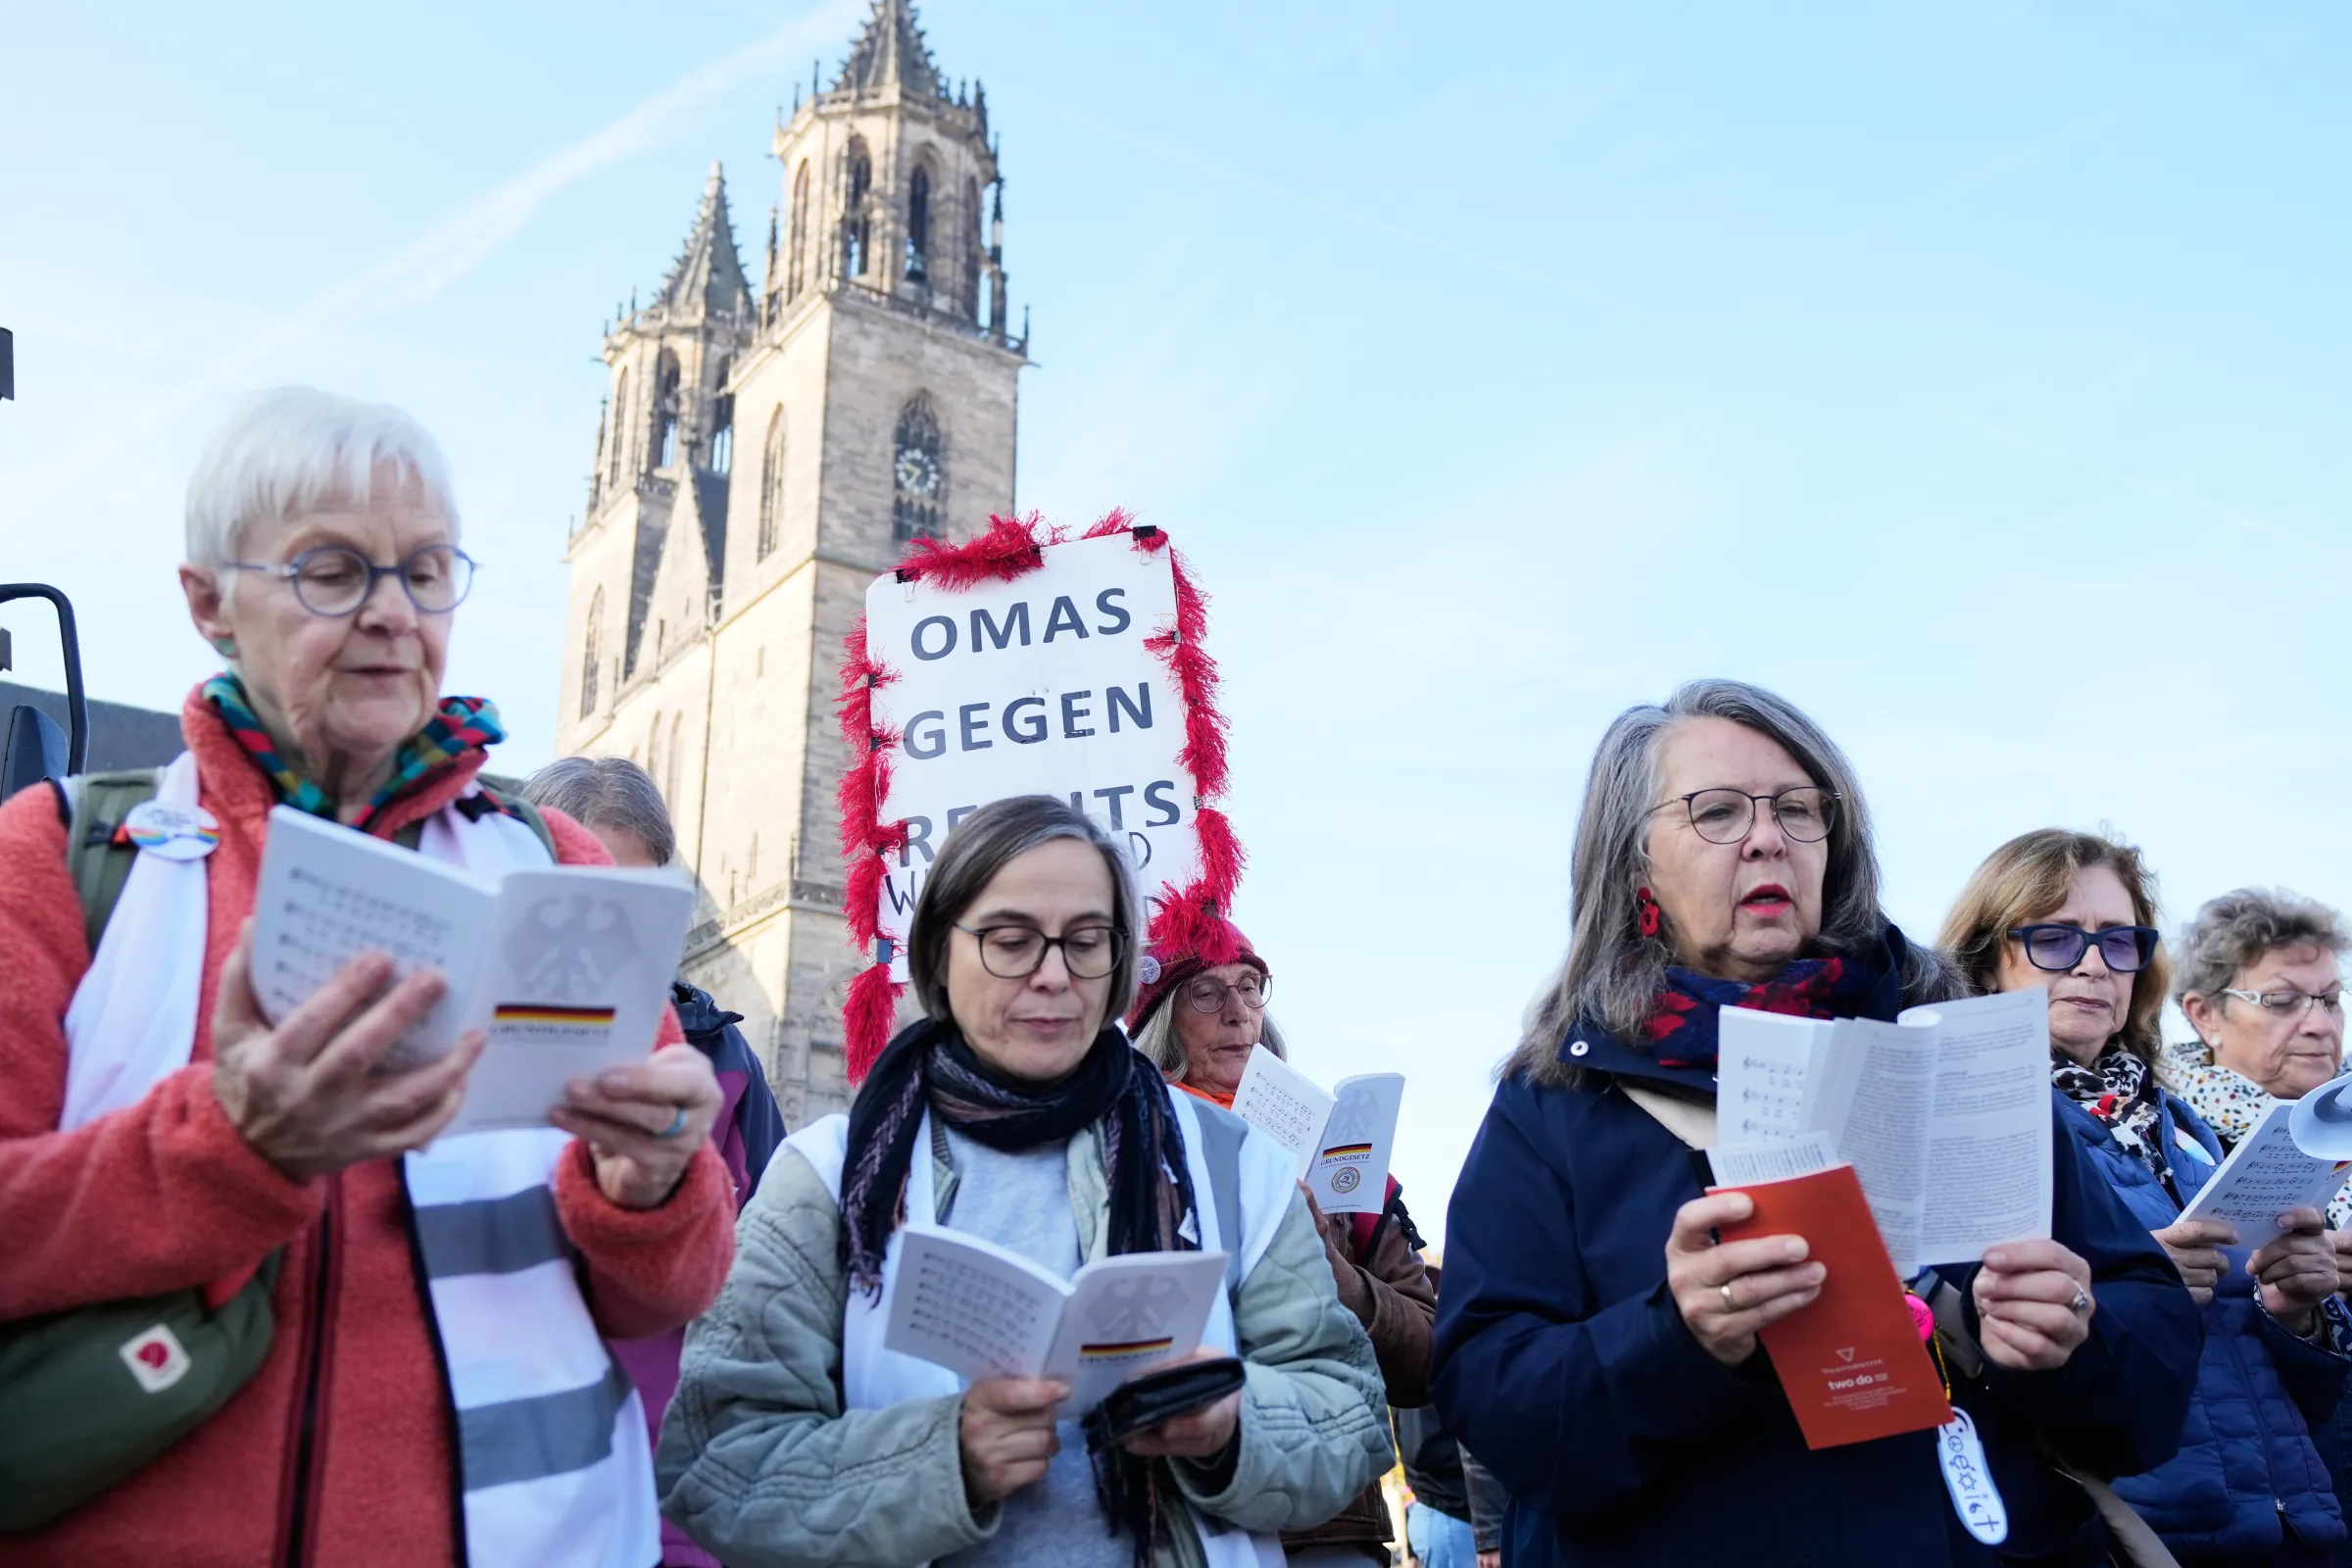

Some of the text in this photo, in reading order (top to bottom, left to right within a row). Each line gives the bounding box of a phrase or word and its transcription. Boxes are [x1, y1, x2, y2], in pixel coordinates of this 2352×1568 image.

[910, 587, 1131, 662] OMAS
[903, 681, 1153, 760] GEGEN
[1320, 1153, 1371, 1166] GRUNDGESETZ
[1828, 1380, 1854, 1391] two
[1855, 1374, 1873, 1385] do
